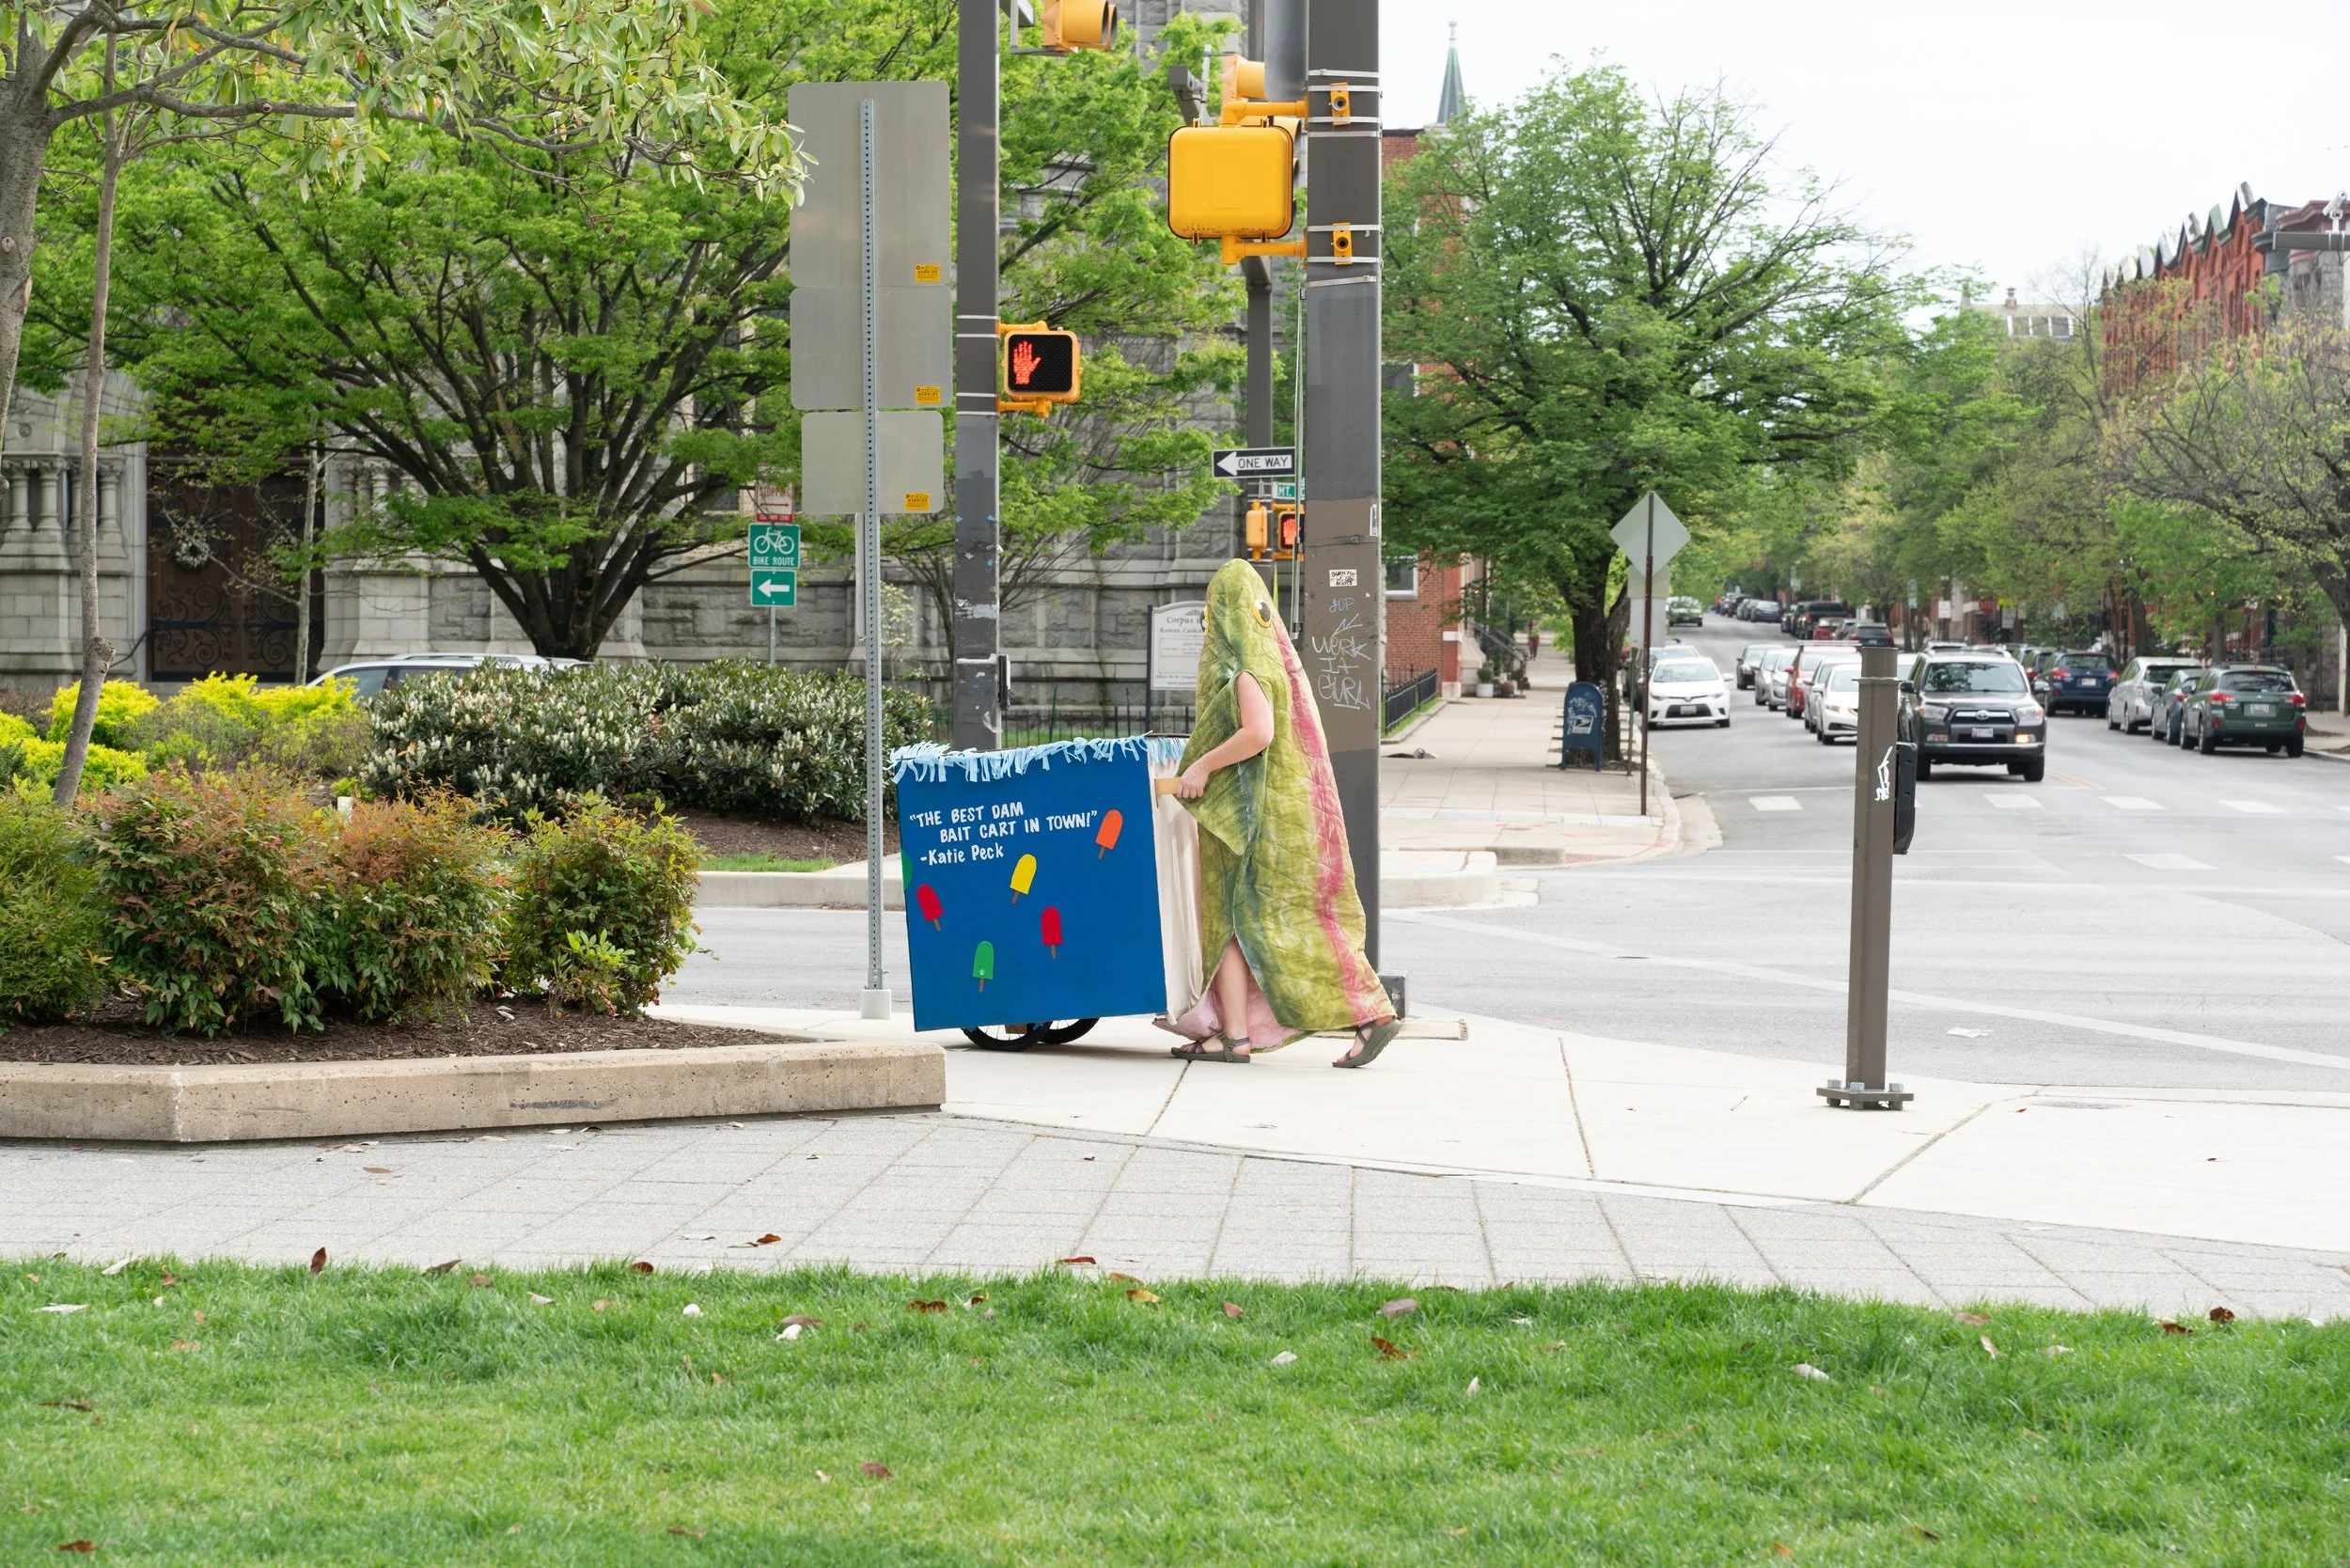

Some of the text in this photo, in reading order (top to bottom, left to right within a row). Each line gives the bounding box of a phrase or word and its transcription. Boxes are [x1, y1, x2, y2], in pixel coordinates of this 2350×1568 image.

[1238, 457, 1289, 469] ONE WAY
[753, 556, 795, 566] BIKE ROUTE
[1167, 616, 1194, 627] Corpus
[950, 805, 984, 824] BEST
[992, 801, 1025, 820] DAM
[939, 826, 971, 843] BAIT
[979, 821, 1016, 839] CART
[1025, 817, 1040, 834] IN
[971, 842, 1004, 861] Peck
